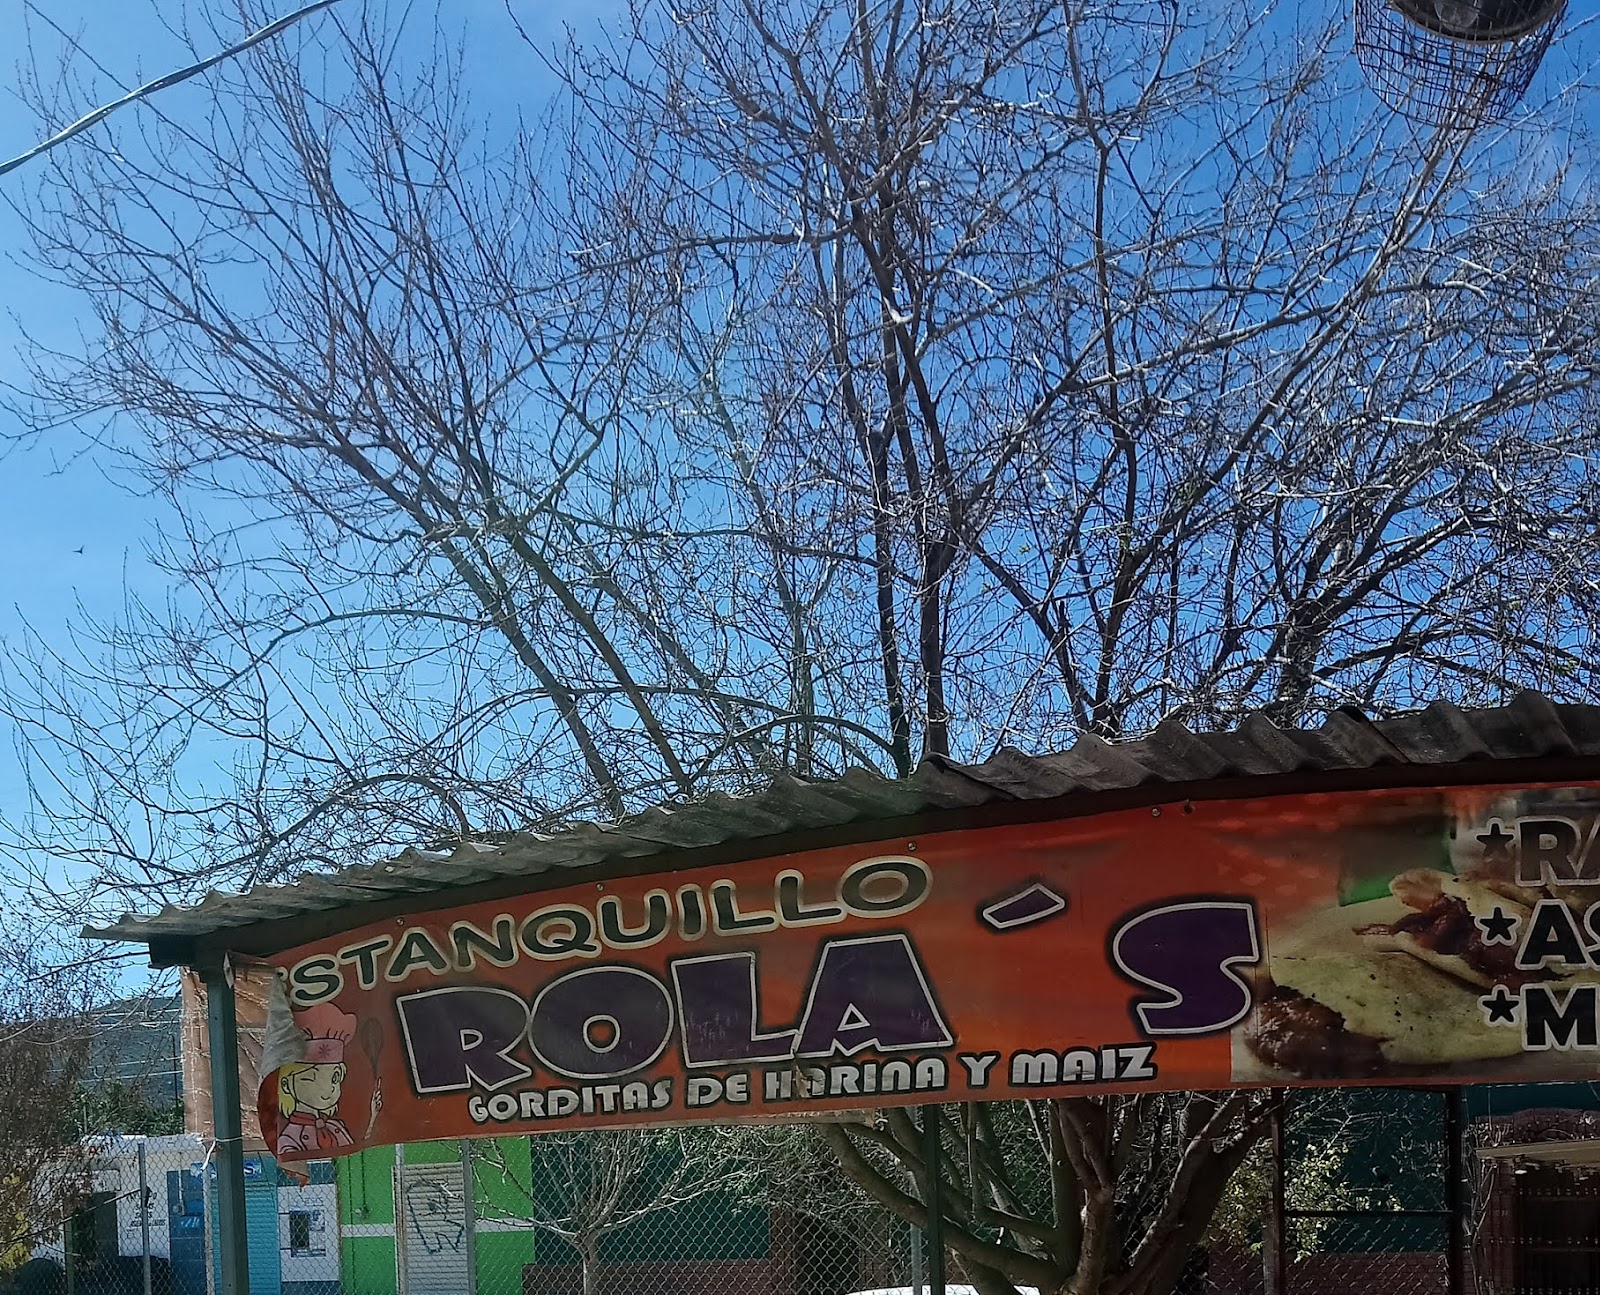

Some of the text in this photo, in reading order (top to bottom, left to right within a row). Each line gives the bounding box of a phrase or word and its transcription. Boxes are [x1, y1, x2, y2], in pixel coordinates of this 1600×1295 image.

[284, 855, 933, 1007] STANQUILLO
[469, 1072, 670, 1123] GORDITAS
[687, 1067, 749, 1109] DE
[957, 1052, 995, 1088] Y
[1009, 1042, 1157, 1086] MAIZ
